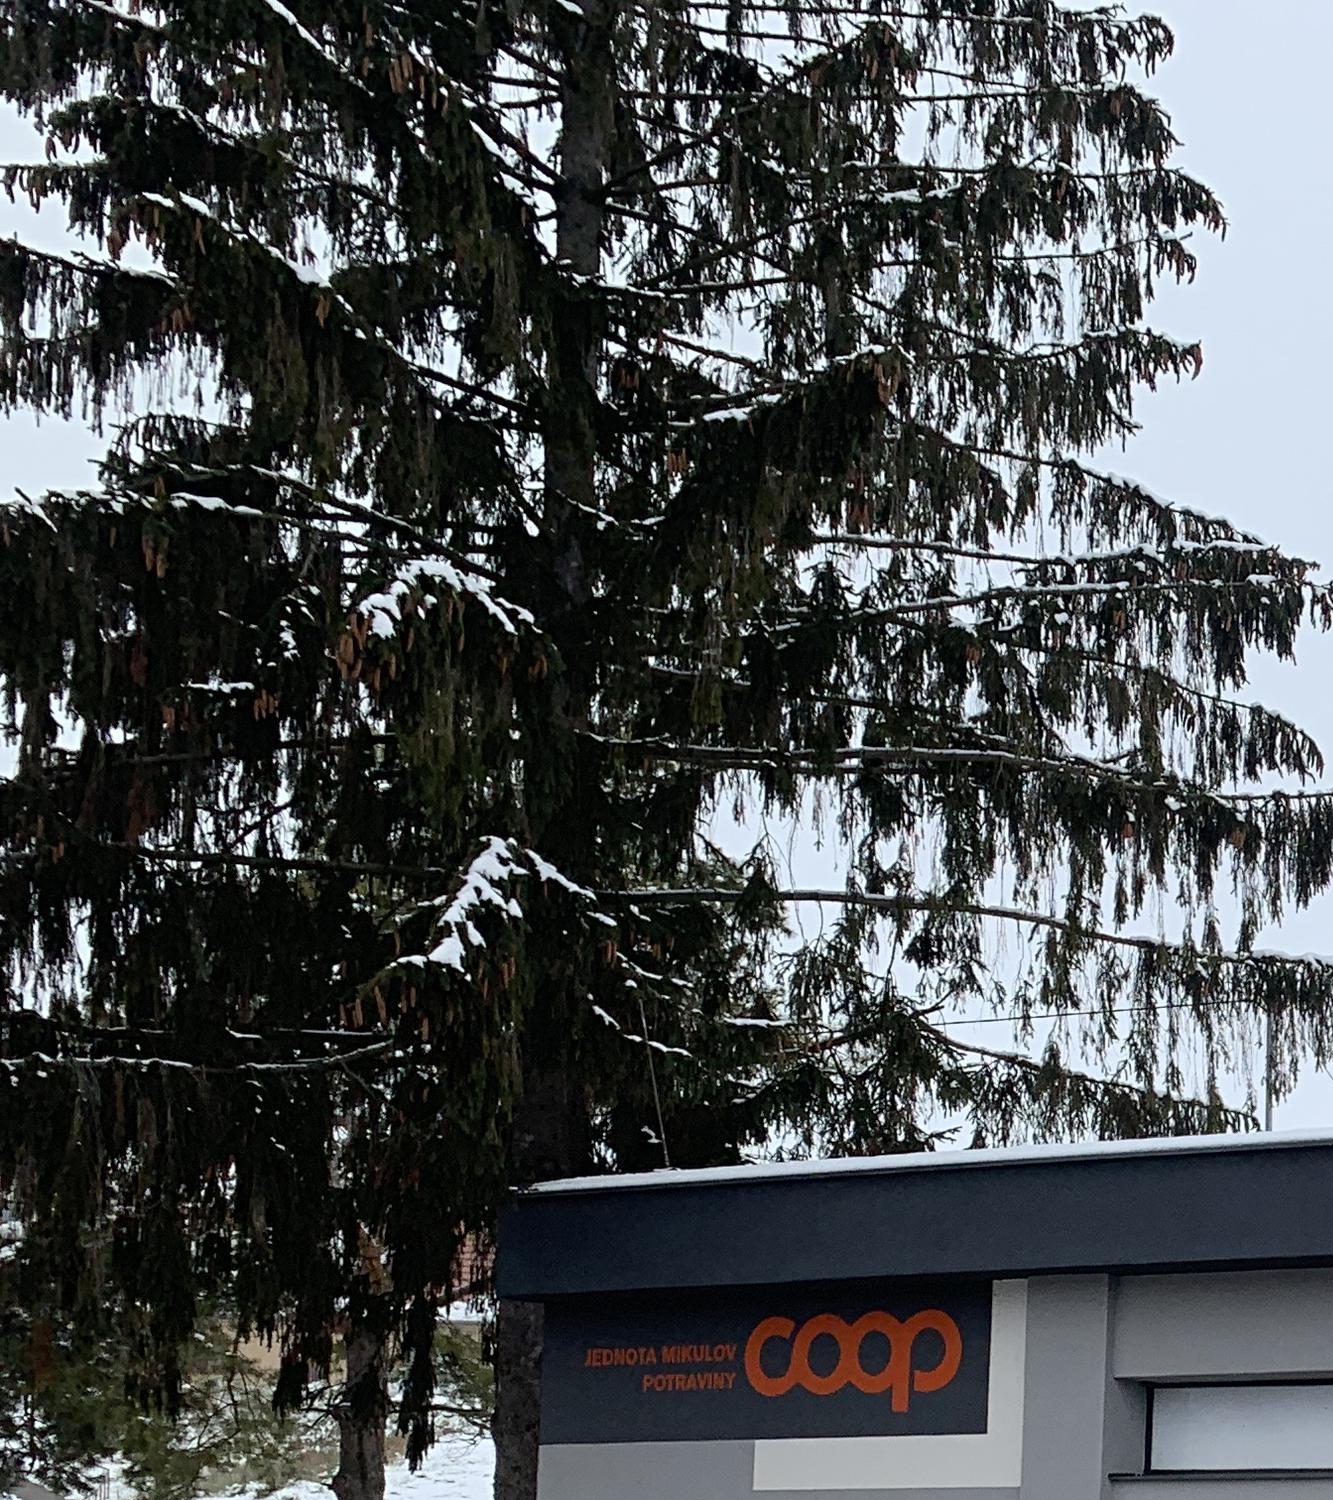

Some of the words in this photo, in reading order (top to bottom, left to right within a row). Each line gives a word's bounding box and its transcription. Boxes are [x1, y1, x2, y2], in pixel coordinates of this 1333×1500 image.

[584, 1345, 657, 1368] JEDNOTA
[661, 1342, 736, 1364] MIKULOV
[744, 1308, 963, 1413] coop
[642, 1371, 736, 1393] POTRAVINY
